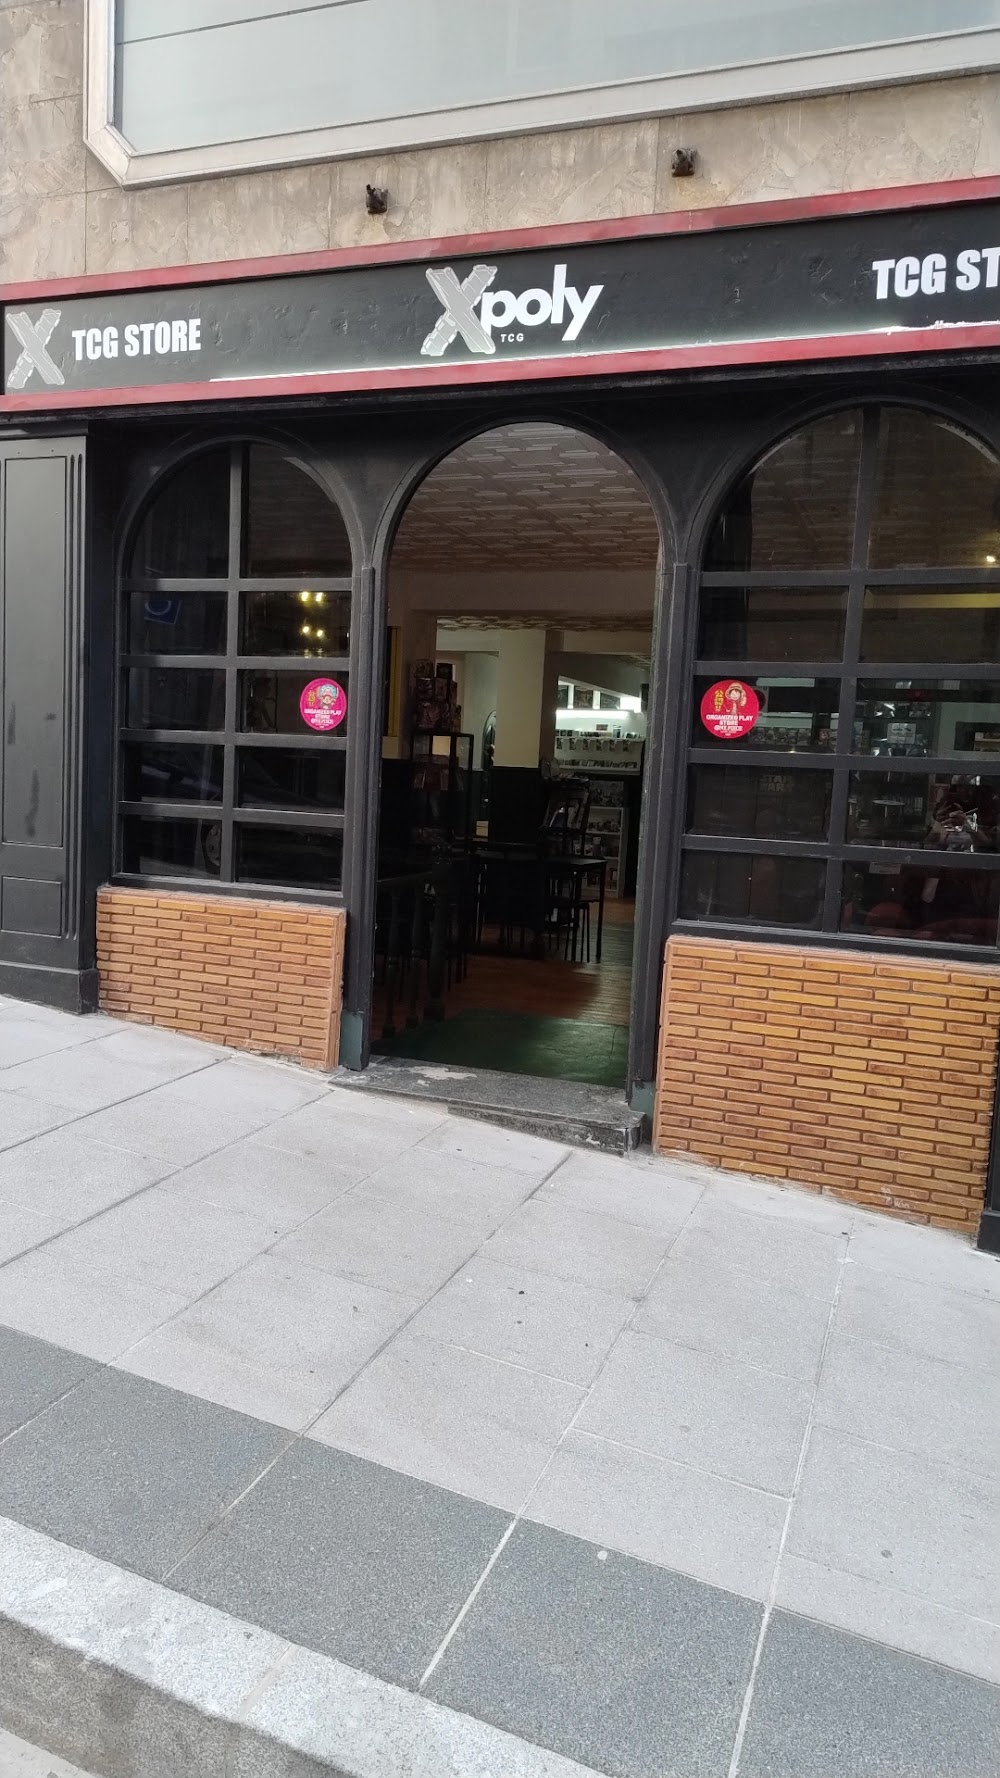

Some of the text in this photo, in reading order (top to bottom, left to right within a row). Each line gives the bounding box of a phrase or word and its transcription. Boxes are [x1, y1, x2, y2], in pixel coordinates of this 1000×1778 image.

[872, 253, 946, 300] TCG
[420, 264, 604, 356] Xpoly
[72, 326, 119, 361] TCG
[124, 318, 202, 357] STORE
[500, 333, 524, 342] TCG
